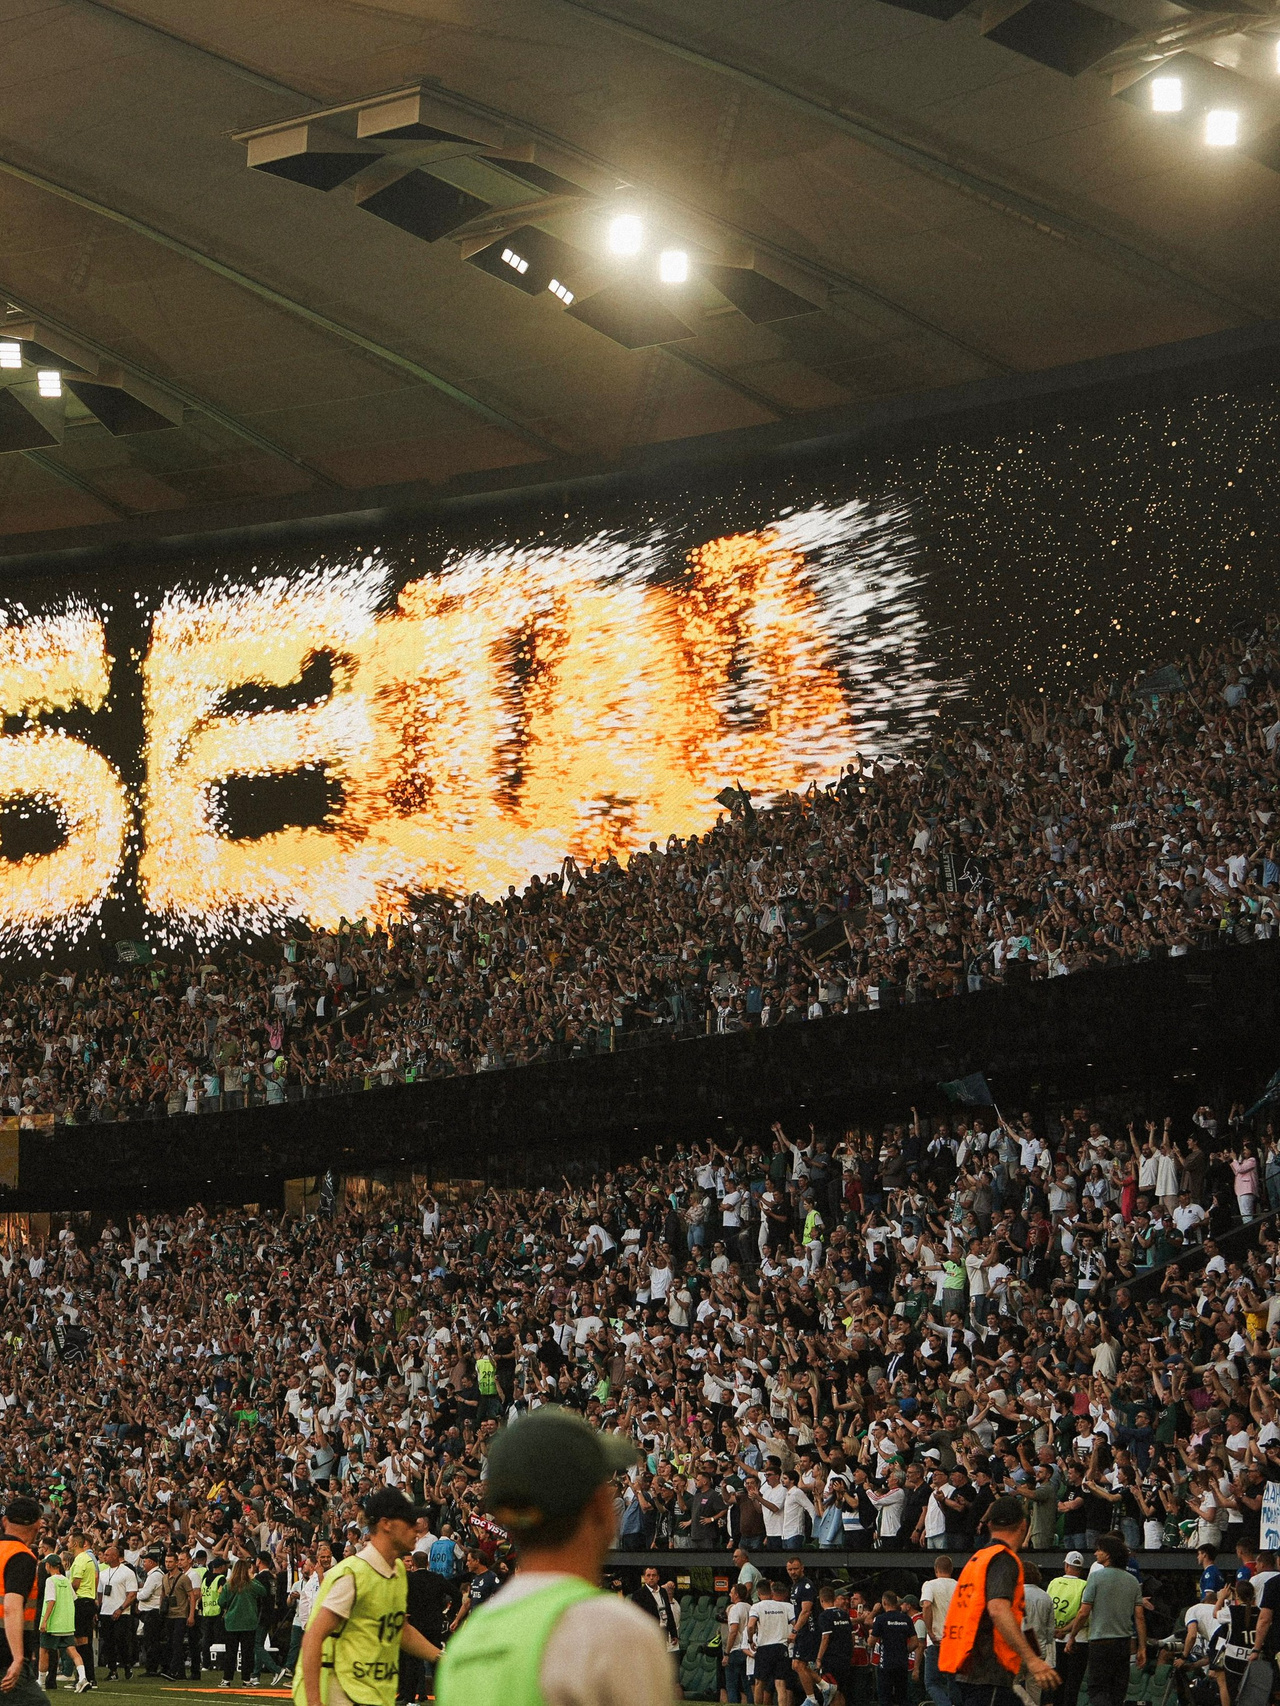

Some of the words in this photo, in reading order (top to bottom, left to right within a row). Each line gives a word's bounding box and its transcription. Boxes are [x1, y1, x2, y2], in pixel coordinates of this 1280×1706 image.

[942, 854, 952, 878] BULLS
[470, 1516, 486, 1528] FDC
[487, 1522, 508, 1539] VISTA
